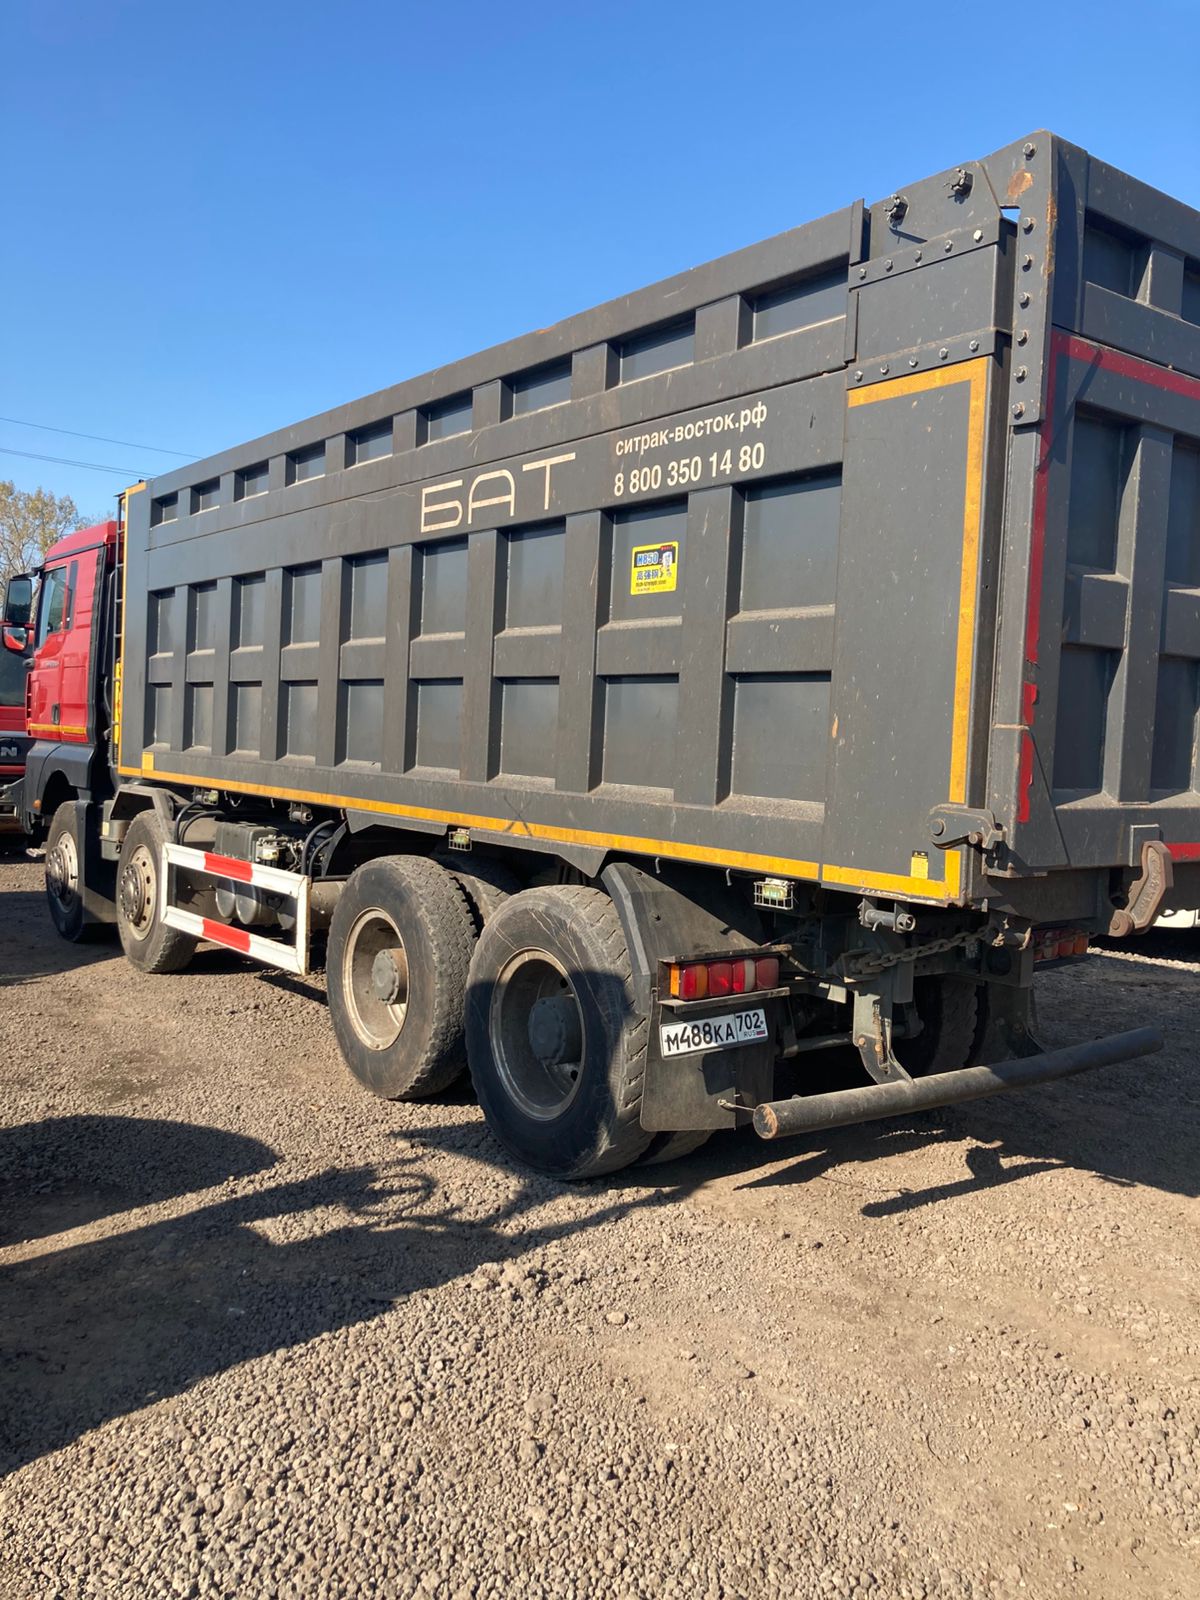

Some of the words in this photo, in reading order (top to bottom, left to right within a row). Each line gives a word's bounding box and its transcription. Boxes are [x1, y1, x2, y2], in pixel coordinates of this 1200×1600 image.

[615, 401, 767, 456] ситрак-восток.рф
[420, 452, 576, 533] БАТ
[613, 472, 624, 497] 8
[629, 464, 662, 494] 800
[667, 455, 702, 486] 350
[709, 449, 732, 477] 14
[738, 442, 765, 472] 80
[736, 1012, 761, 1031] 702
[743, 1030, 757, 1038] RUS
